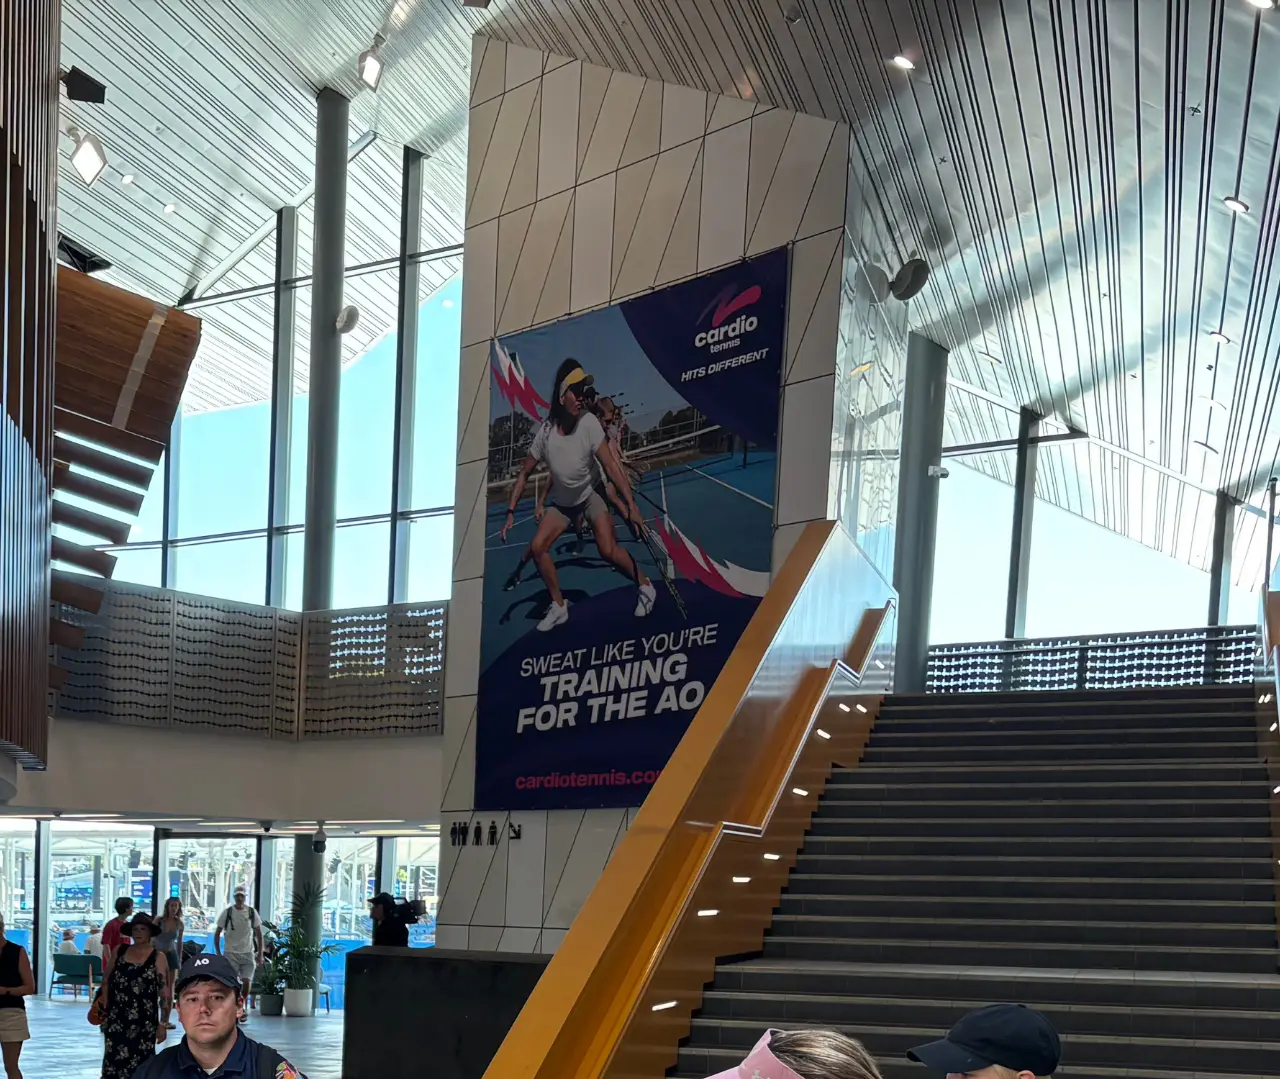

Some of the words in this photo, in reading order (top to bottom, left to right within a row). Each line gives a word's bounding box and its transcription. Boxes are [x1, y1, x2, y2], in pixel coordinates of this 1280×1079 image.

[694, 314, 758, 347] cardio
[709, 338, 741, 353] tennis
[681, 366, 706, 382] HITS
[707, 347, 769, 375] DIFFERENT
[520, 648, 587, 677] SWEAT
[590, 639, 635, 666] LIKE
[641, 623, 719, 656] YOU'RE
[540, 653, 688, 702] TRAINING
[516, 702, 579, 734] FOR
[587, 690, 648, 724] THE
[653, 680, 705, 715] AO
[515, 769, 661, 789] cardiotennis.co
[194, 958, 210, 967] AO
